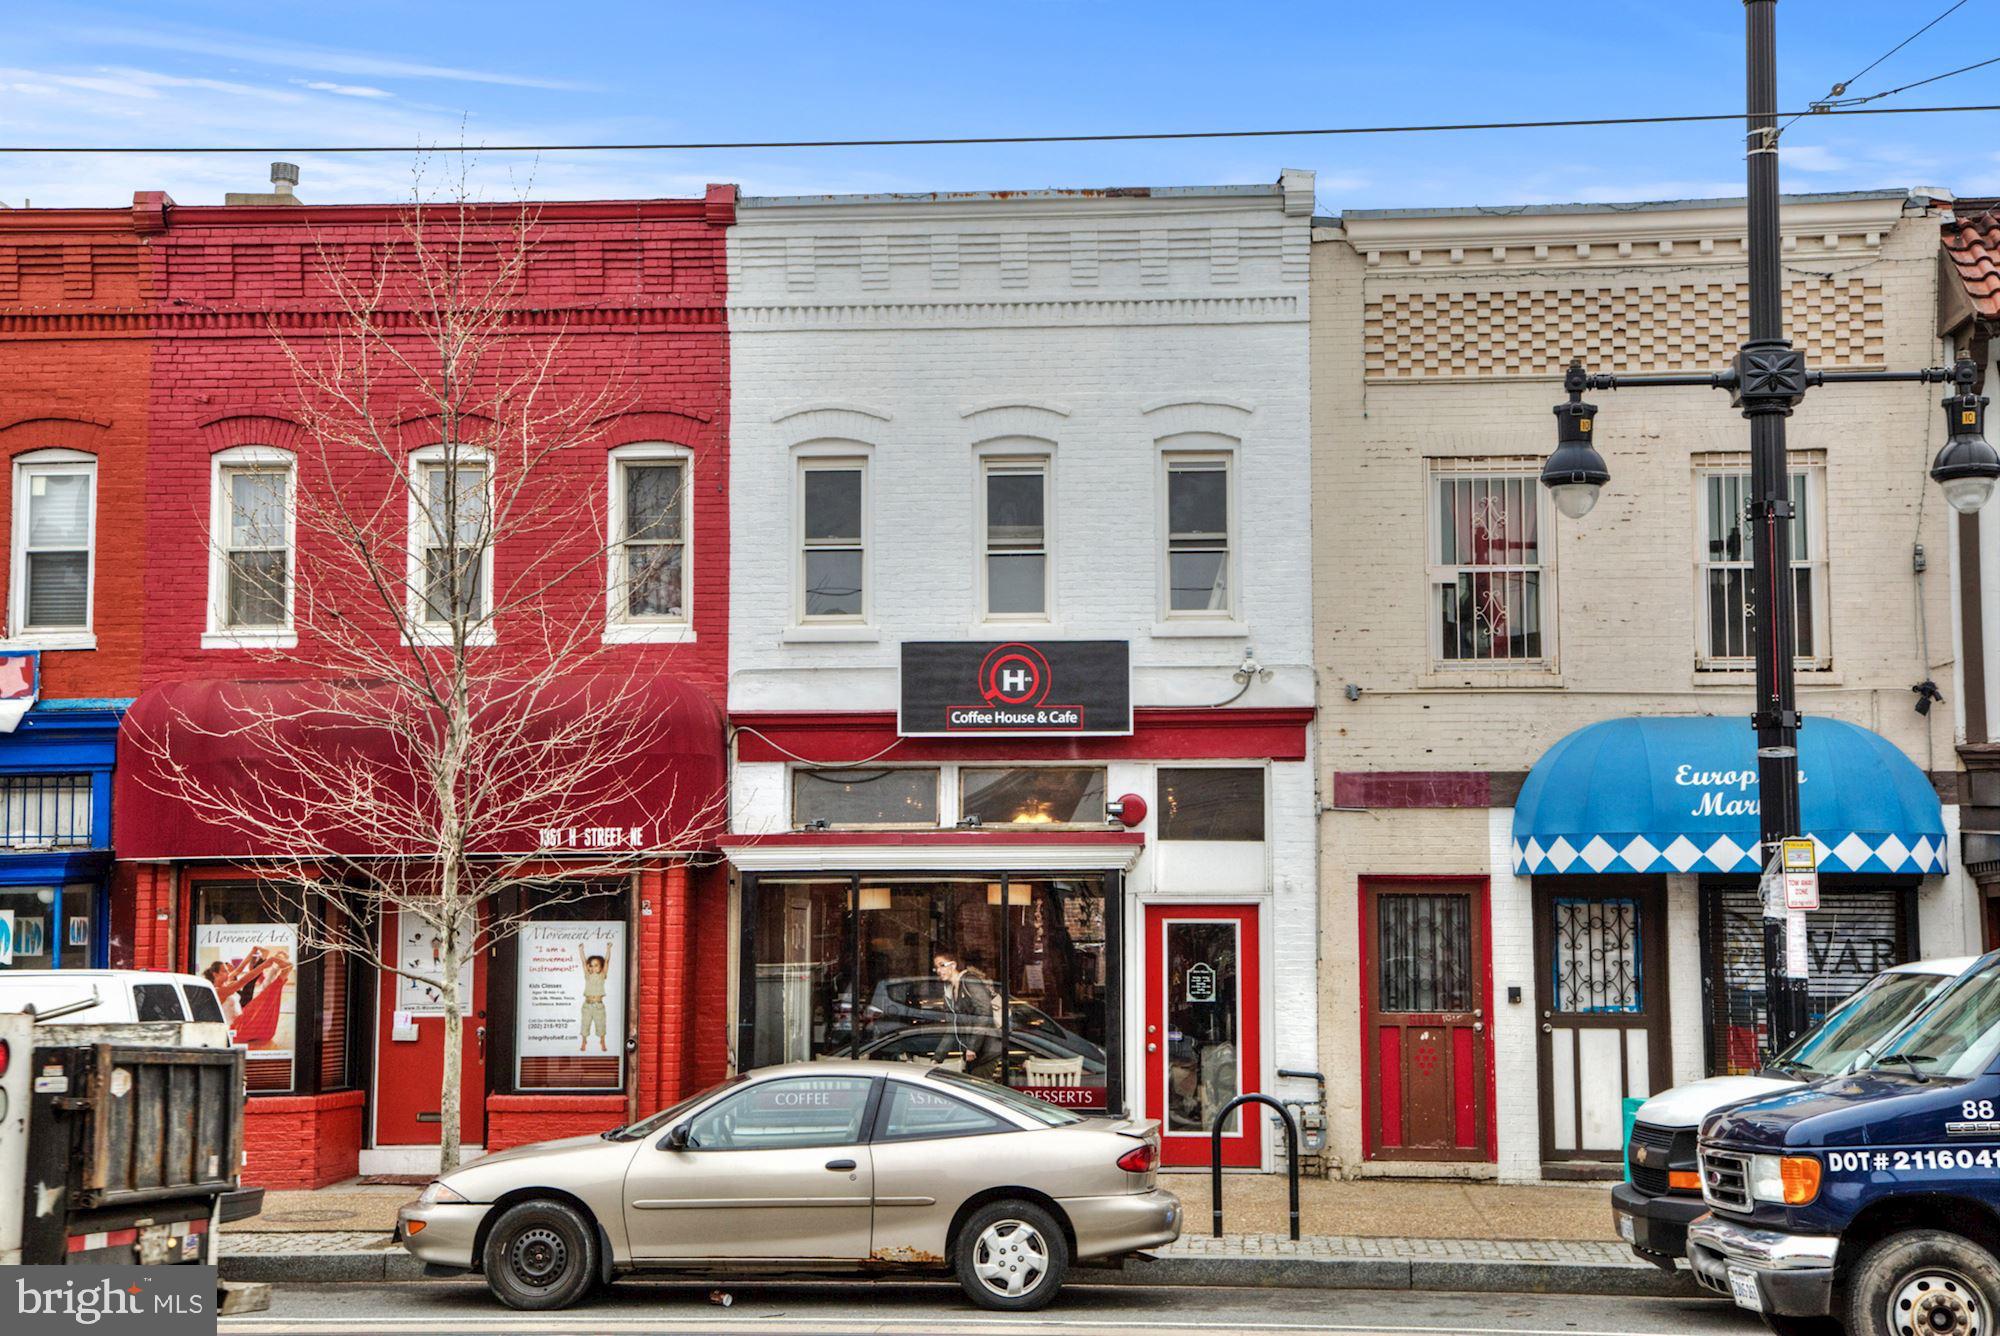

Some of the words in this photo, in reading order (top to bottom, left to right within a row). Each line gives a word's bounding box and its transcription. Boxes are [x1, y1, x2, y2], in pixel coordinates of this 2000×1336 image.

[1002, 669, 1025, 692] H
[951, 710, 992, 724] Coffee
[995, 711, 1034, 724] House
[1036, 711, 1048, 724] &
[1050, 710, 1078, 724] Cafe
[1691, 792, 1760, 816] Mar
[568, 827, 577, 846] H
[584, 827, 622, 846] STREET
[630, 827, 643, 846] NE
[775, 1092, 830, 1106] COFFEE
[1962, 1100, 1995, 1120] 88
